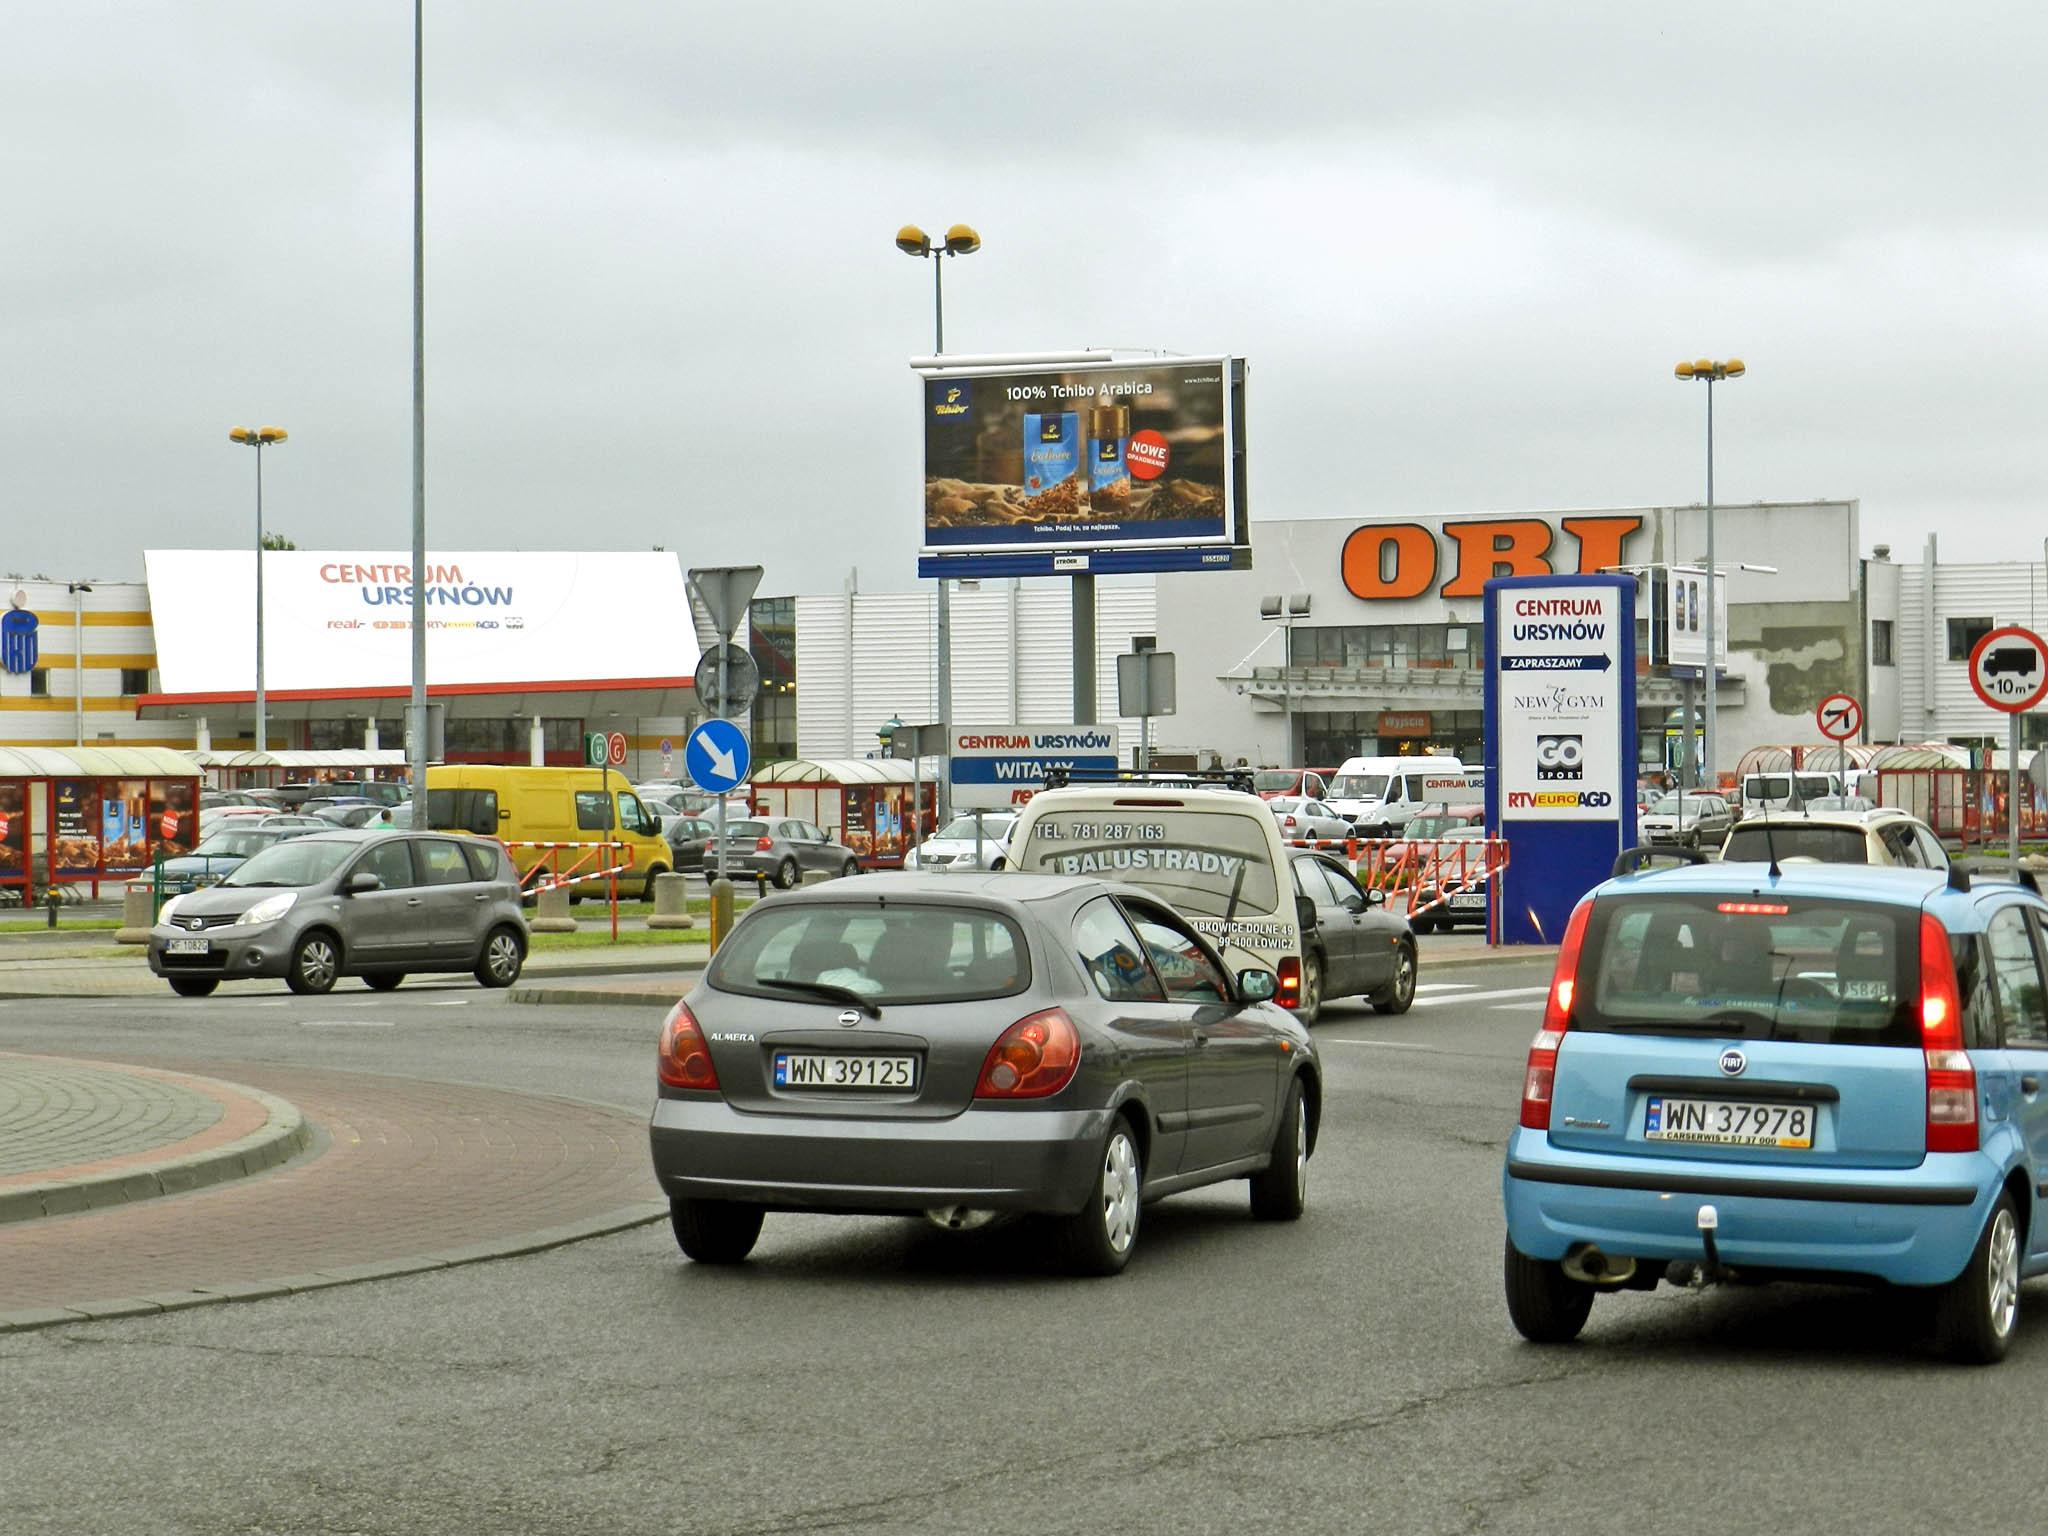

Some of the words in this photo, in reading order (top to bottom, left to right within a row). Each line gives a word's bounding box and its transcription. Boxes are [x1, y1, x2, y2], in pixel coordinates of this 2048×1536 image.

[1006, 385, 1047, 400] 100%
[1051, 382, 1095, 398] Tchibo
[1099, 380, 1153, 396] Arabica
[1131, 441, 1166, 459] NOWE
[1341, 515, 1643, 600] OBI
[1515, 599, 1602, 616] CENTRUM
[1513, 619, 1605, 640] URSYNÓW
[1510, 658, 1583, 668] ZAPRASZAMY
[1997, 679, 2014, 694] 10
[1514, 695, 1550, 709] NEW
[1567, 695, 1604, 708] GYM
[958, 735, 1031, 749] CENTRUM
[1034, 731, 1111, 749] URSYNÓW
[1537, 737, 1584, 767] GO
[1538, 771, 1582, 780] SPORT
[1425, 779, 1466, 789] CENTRUM
[1035, 823, 1067, 839] TEL.
[1072, 824, 1099, 839] 781
[1104, 825, 1132, 839] 287
[1137, 825, 1165, 840] 163
[1061, 849, 1237, 877] BALUSTRADY
[1246, 923, 1278, 934] DOLNE
[1280, 924, 1293, 936] 49
[1219, 937, 1252, 947] 99-400
[711, 1032, 755, 1042] ALMERA
[792, 1057, 825, 1082] WN
[834, 1059, 909, 1084] 39125
[1723, 1057, 1742, 1068] FIAT
[776, 1072, 786, 1081] PL
[1666, 1102, 1708, 1131] WN
[1717, 1106, 1806, 1137] 37978
[1666, 1131, 1721, 1142] CARSERWIS
